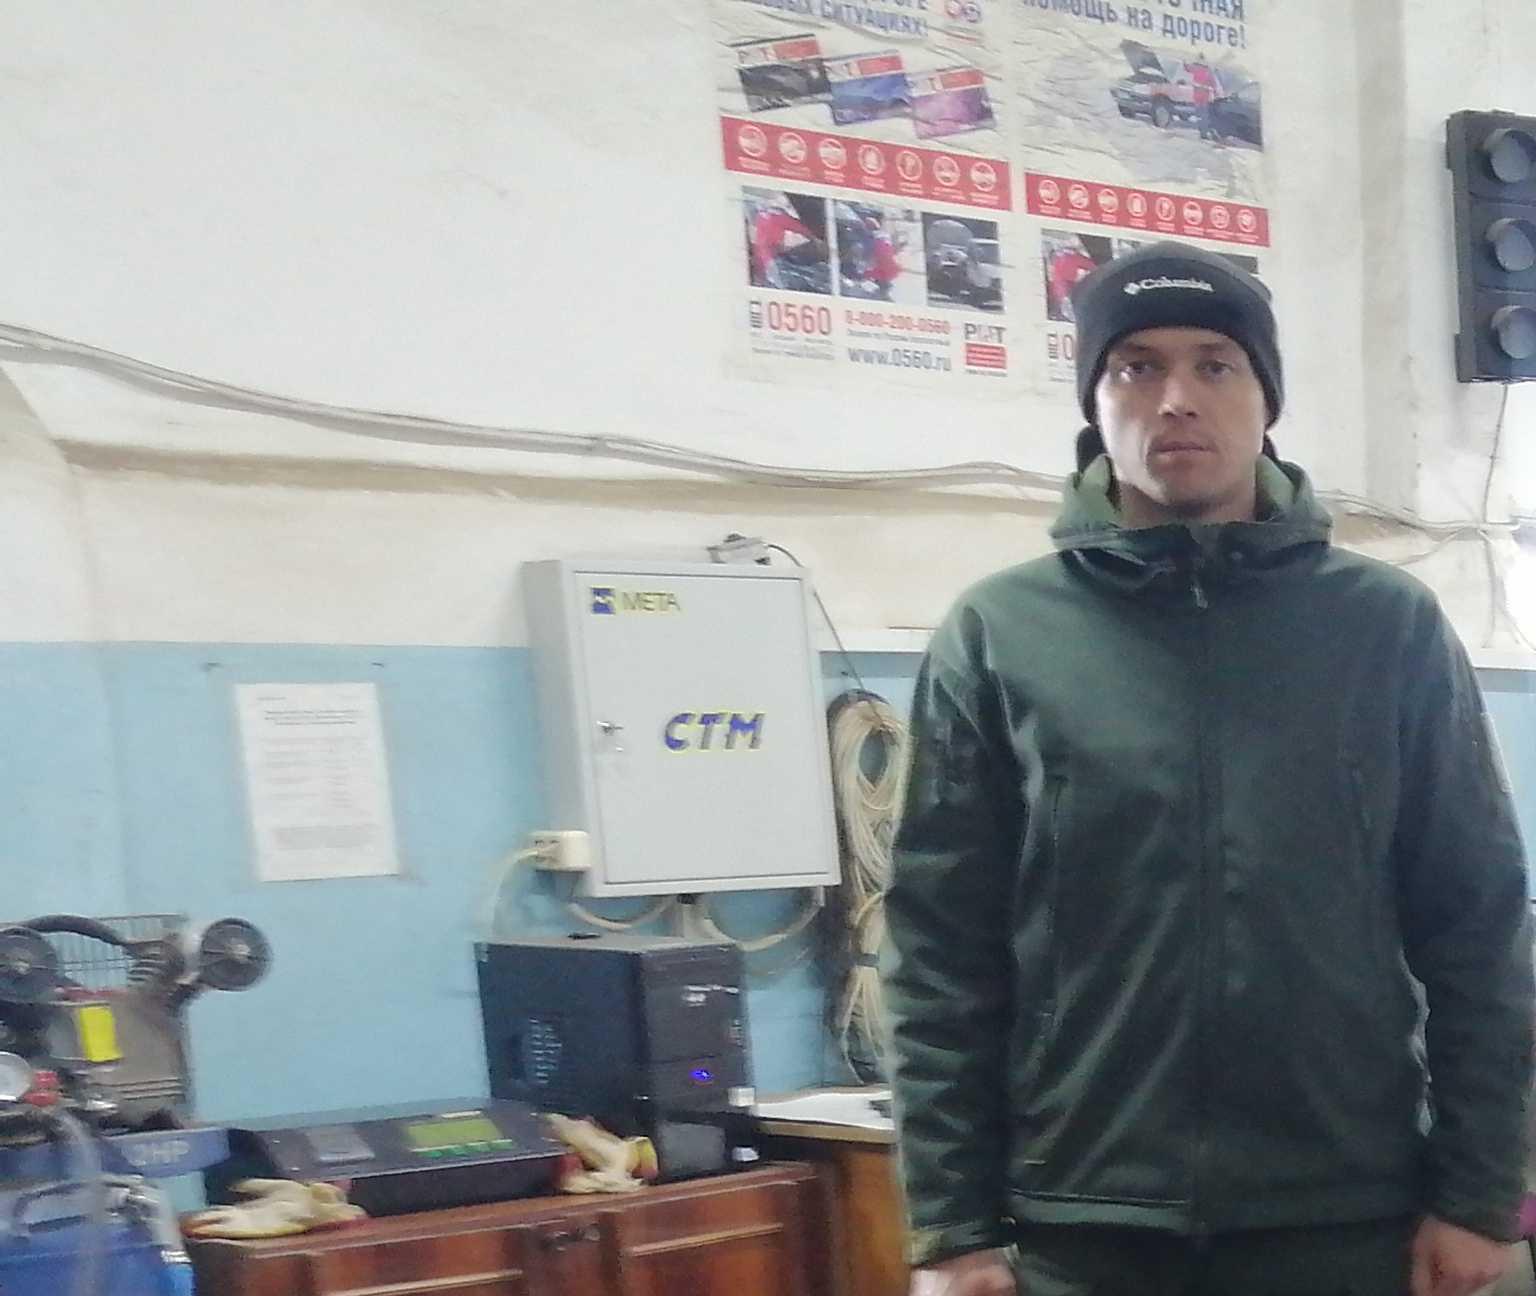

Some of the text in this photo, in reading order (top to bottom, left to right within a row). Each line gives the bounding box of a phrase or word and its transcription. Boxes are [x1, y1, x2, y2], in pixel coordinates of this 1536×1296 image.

[1126, 5, 1153, 31] на
[1162, 12, 1246, 49] дороге!
[767, 300, 832, 336] 0560
